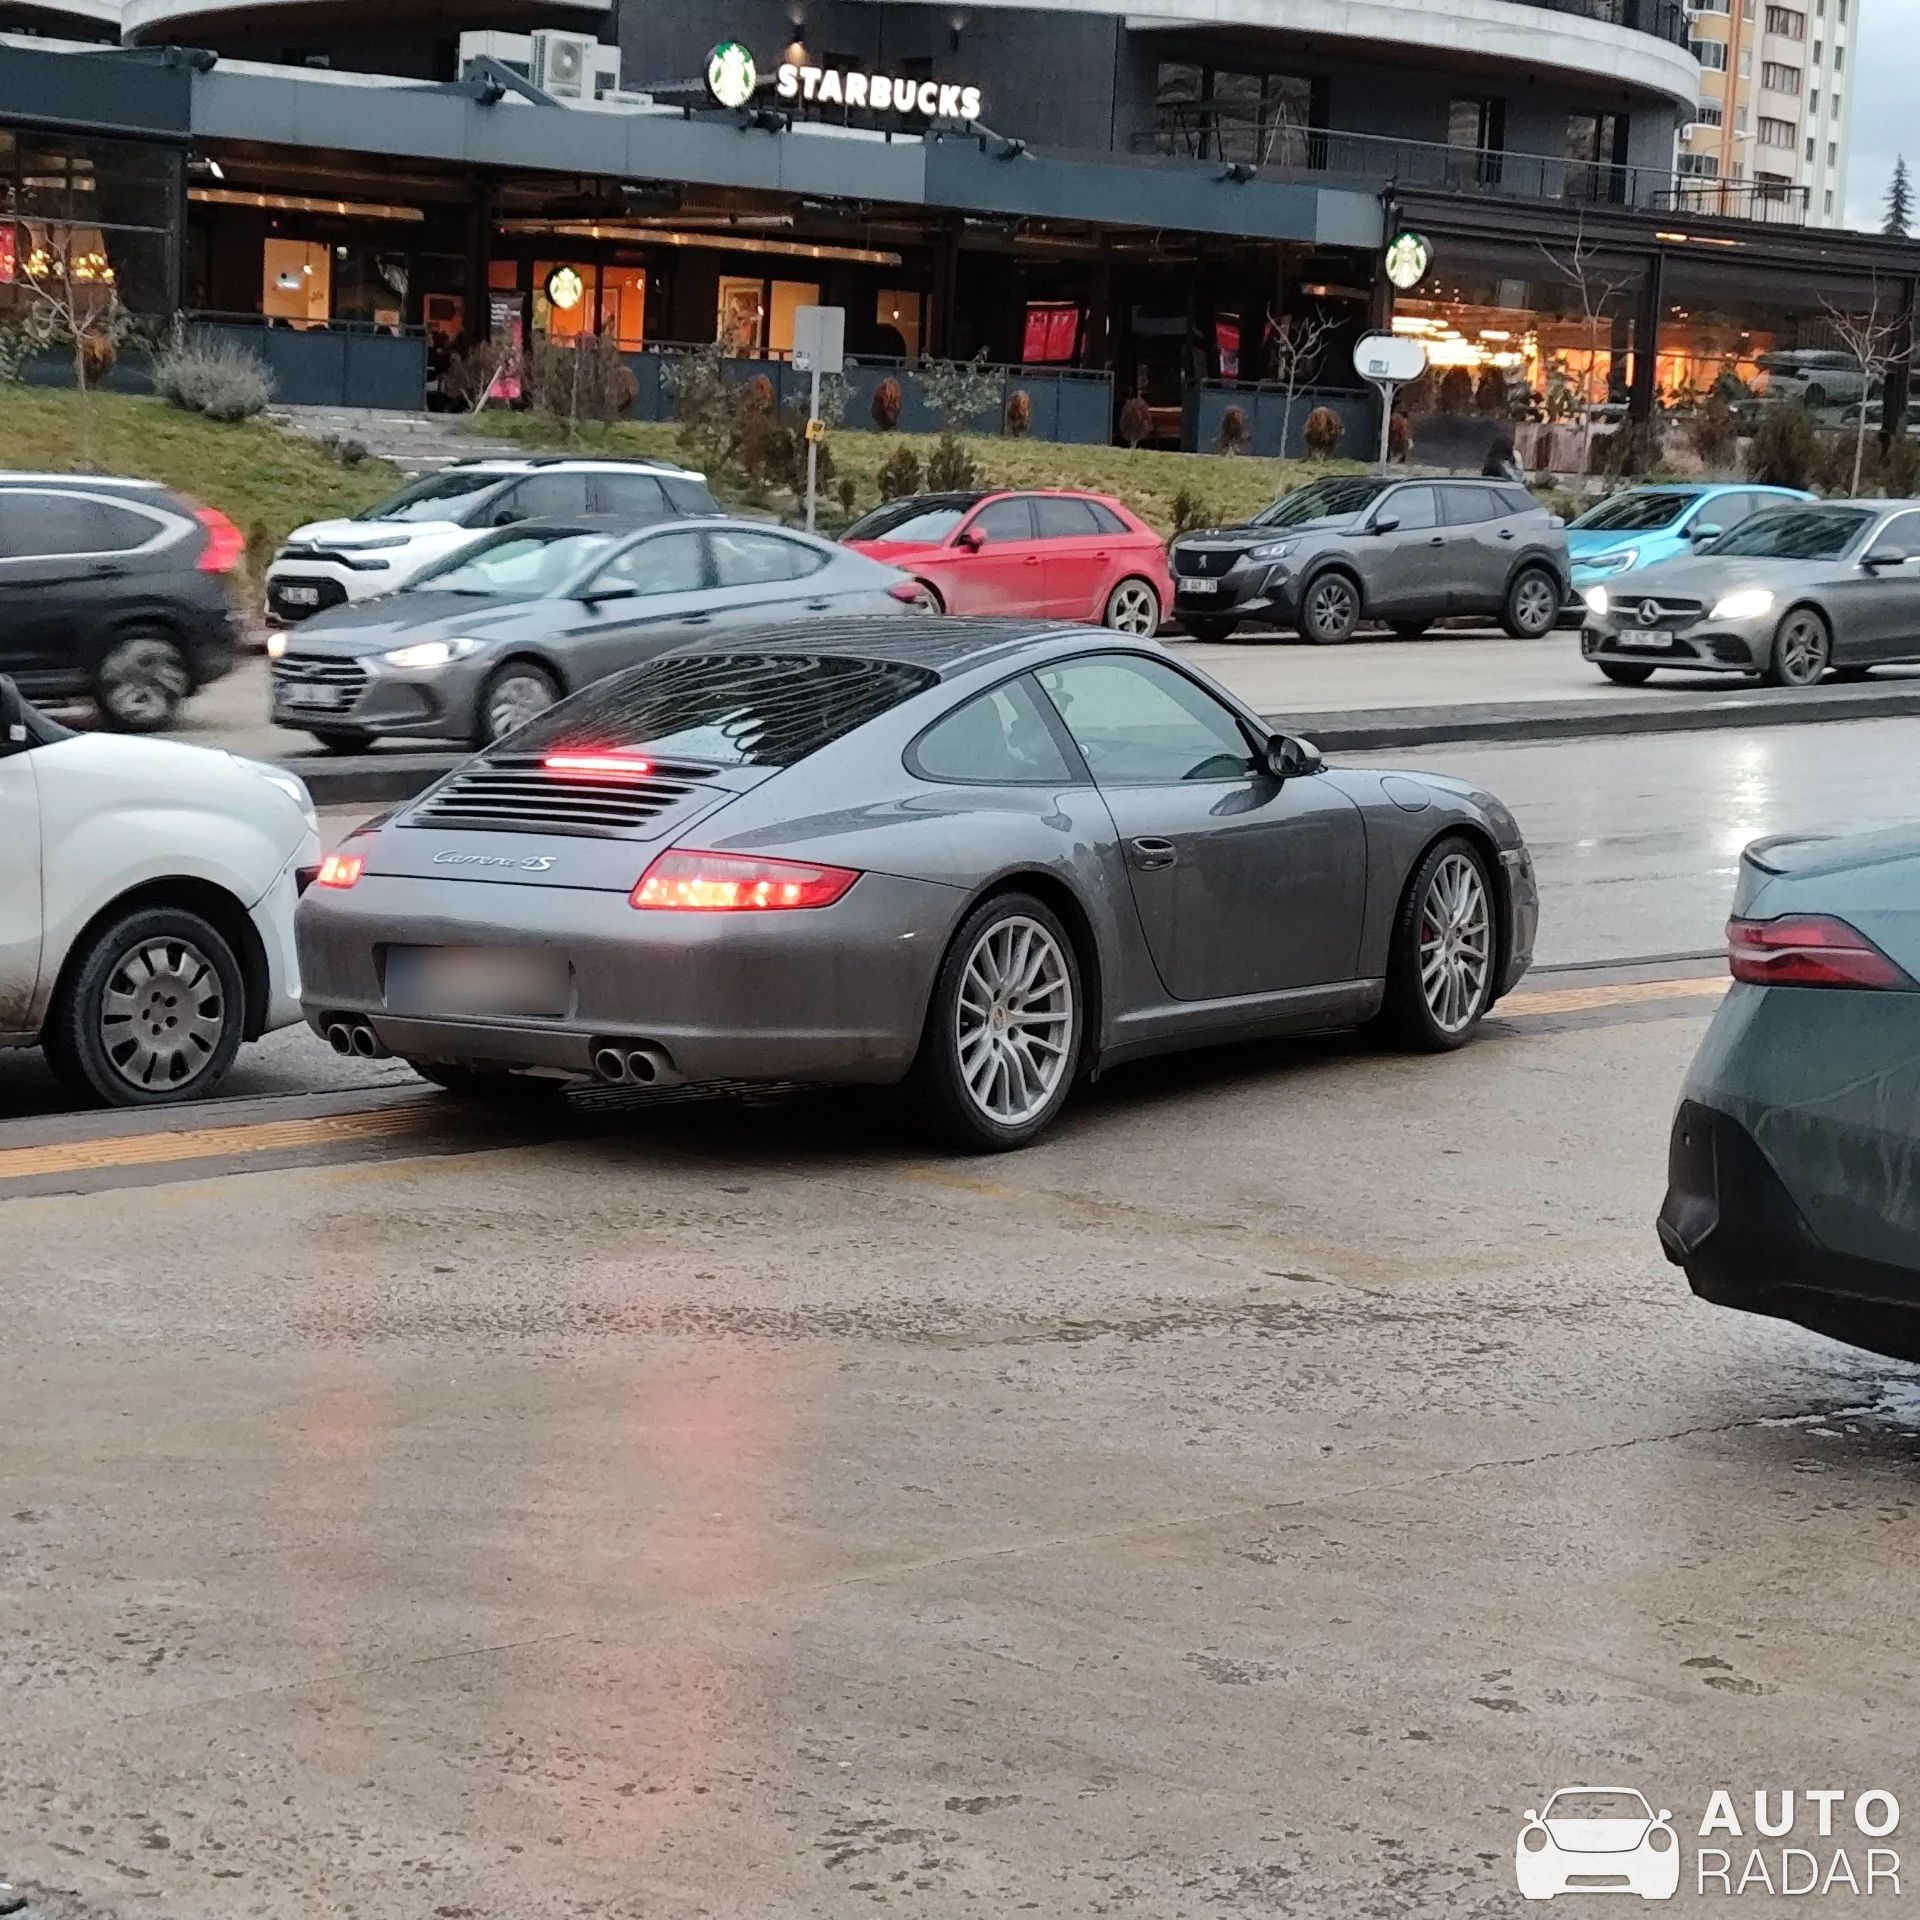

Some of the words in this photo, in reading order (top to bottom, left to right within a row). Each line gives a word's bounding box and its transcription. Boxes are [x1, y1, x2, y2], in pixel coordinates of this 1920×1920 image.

[777, 63, 981, 120] STARBUCKS
[433, 849, 516, 867] Carrera
[520, 856, 557, 871] 4S
